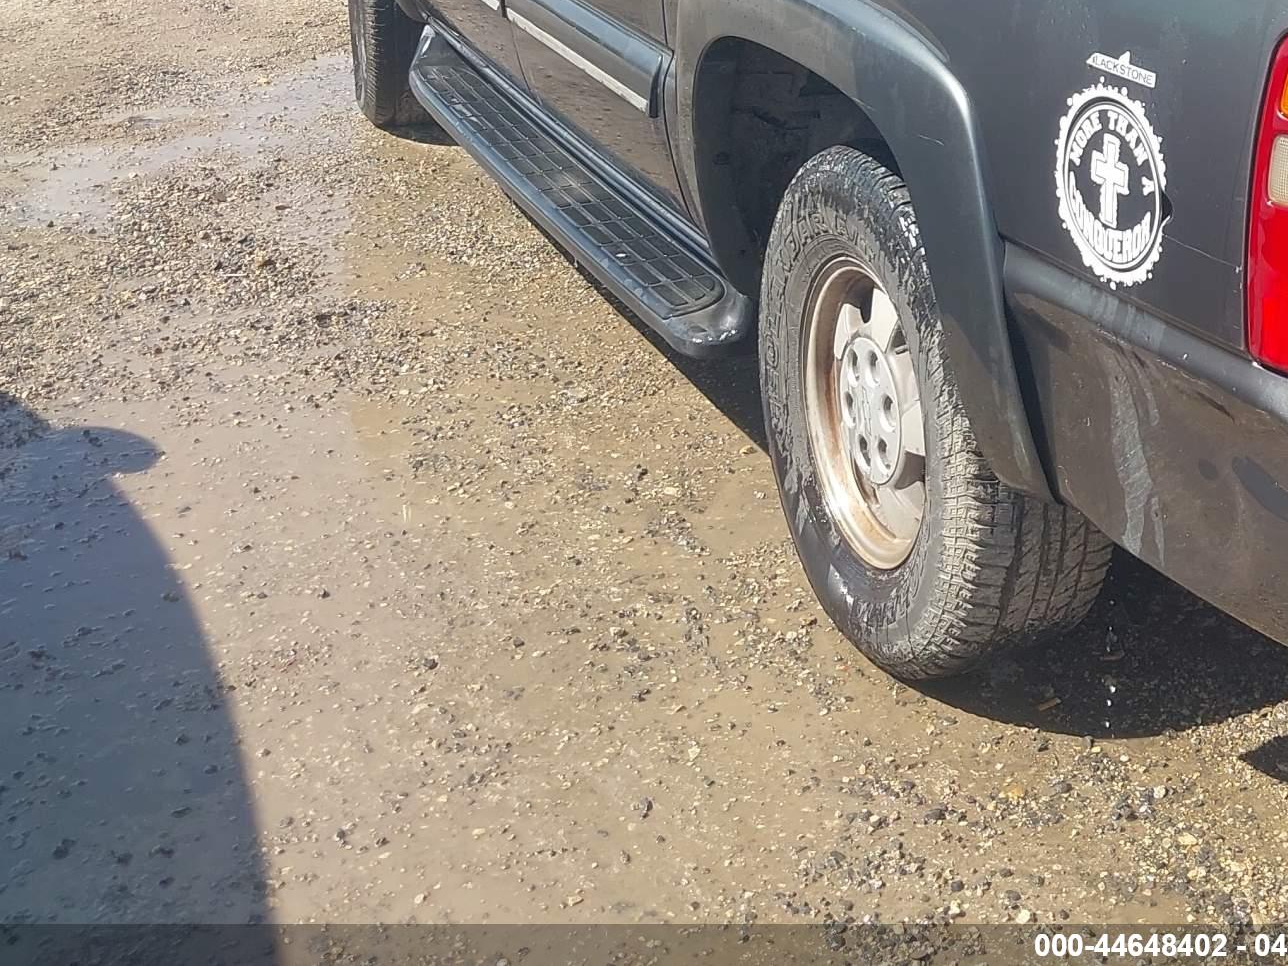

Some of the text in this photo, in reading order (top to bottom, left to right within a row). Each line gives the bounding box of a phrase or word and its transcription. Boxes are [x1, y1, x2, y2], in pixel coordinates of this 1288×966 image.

[1069, 110, 1156, 196] MORE THAN A
[1068, 170, 1152, 263] CONQUEROR
